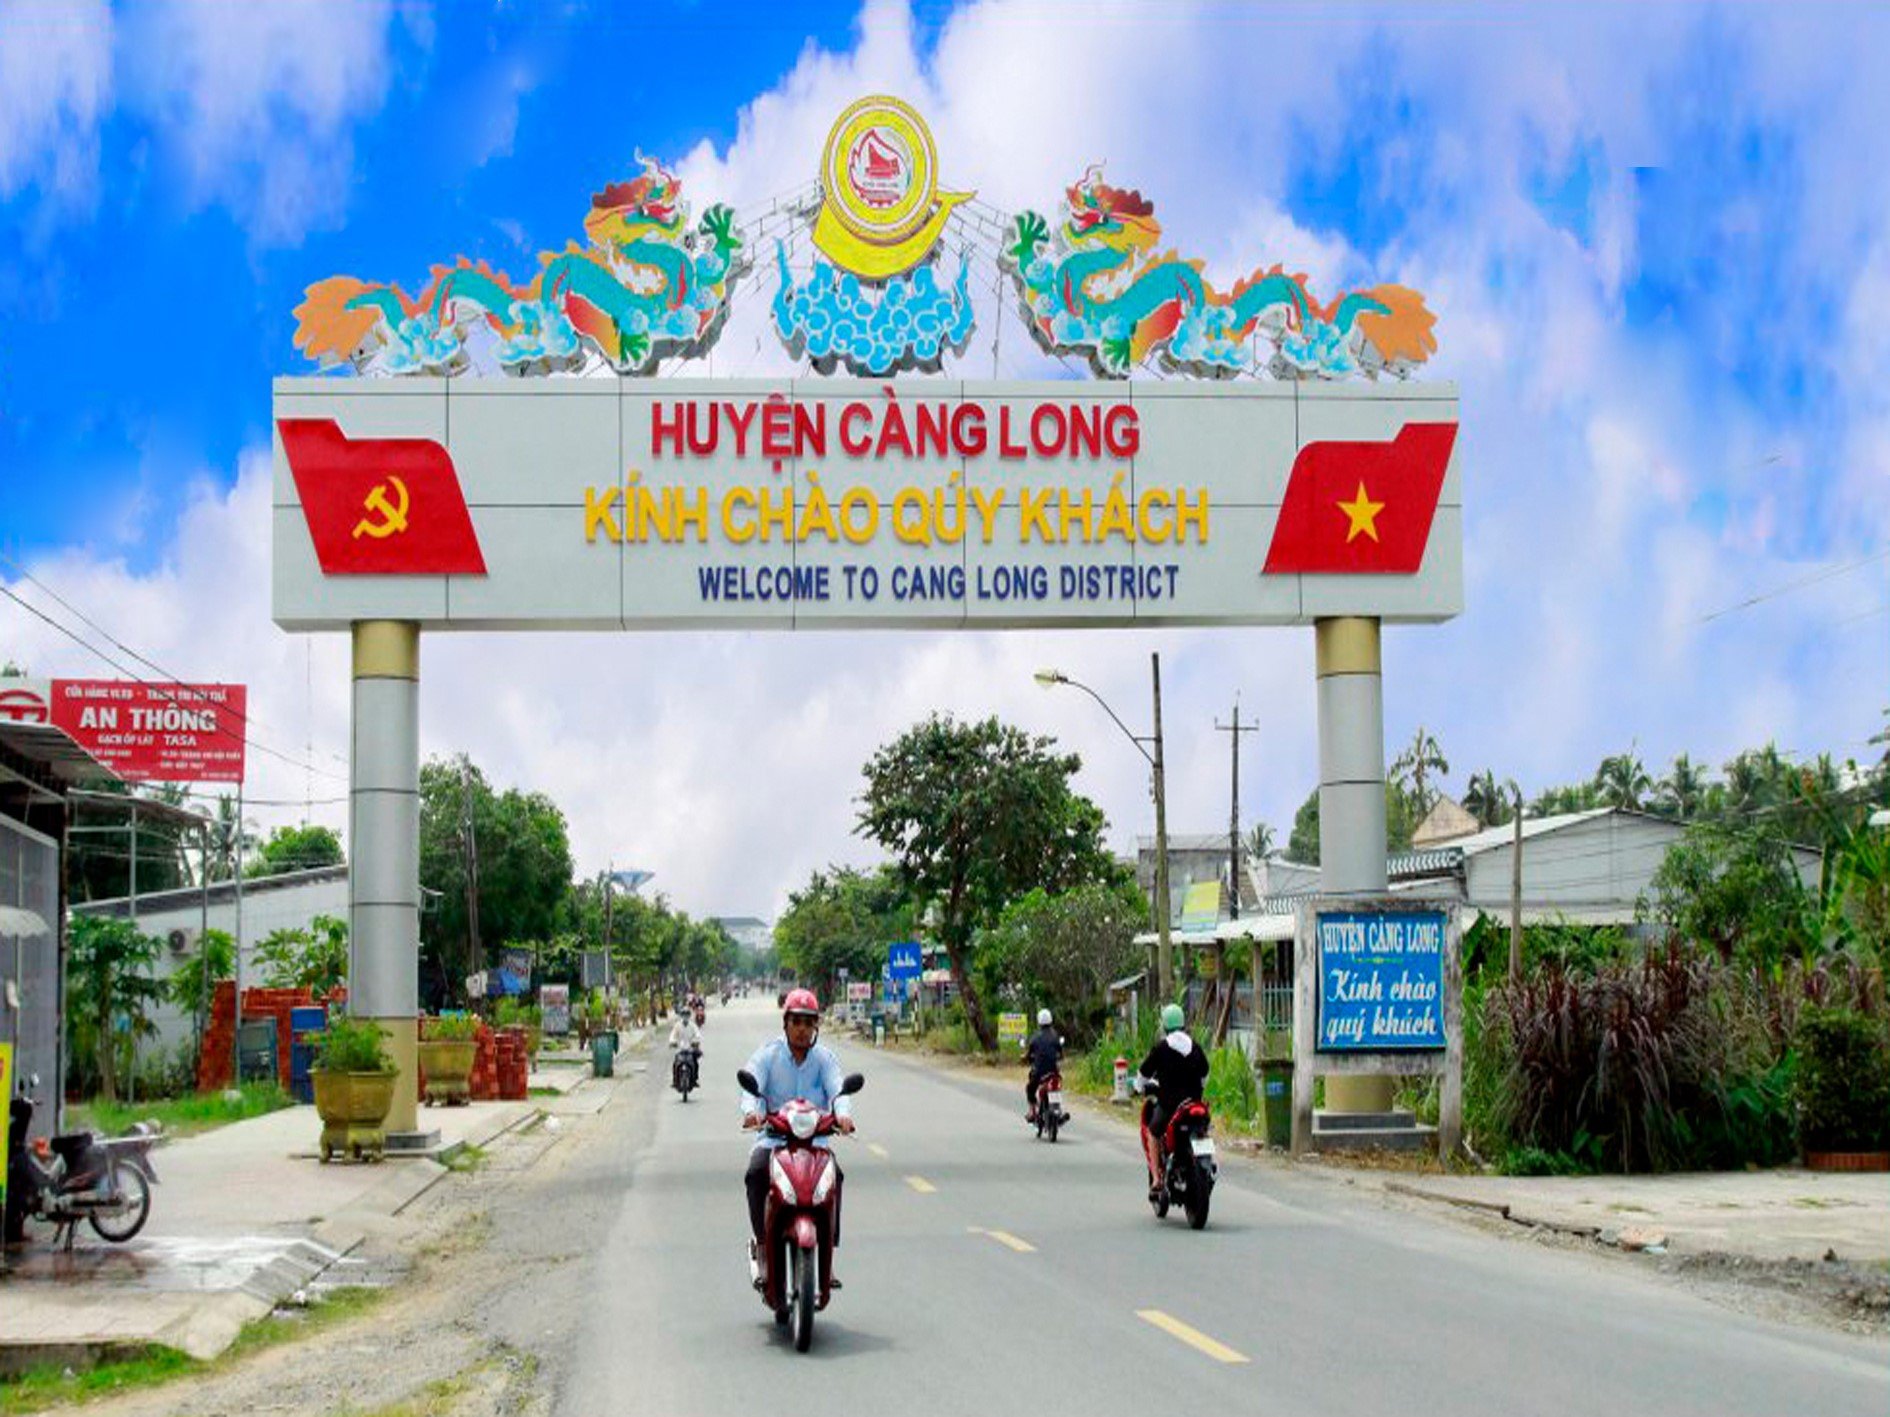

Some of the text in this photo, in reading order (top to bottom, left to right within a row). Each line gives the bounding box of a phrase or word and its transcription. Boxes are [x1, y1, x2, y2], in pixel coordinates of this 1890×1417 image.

[651, 387, 1140, 472] HUYỆN CÀNG LONG
[584, 471, 1209, 546] KÍNH CHÀO QÚY KHÁCH
[699, 565, 1179, 600] WELCOME TO CANG LONG DISTRICT
[79, 702, 217, 732] AN THÔNG
[164, 734, 197, 746] TASA
[1322, 914, 1440, 960] HUYỆN CÀNG LONG
[1327, 967, 1437, 1003] Kính chào
